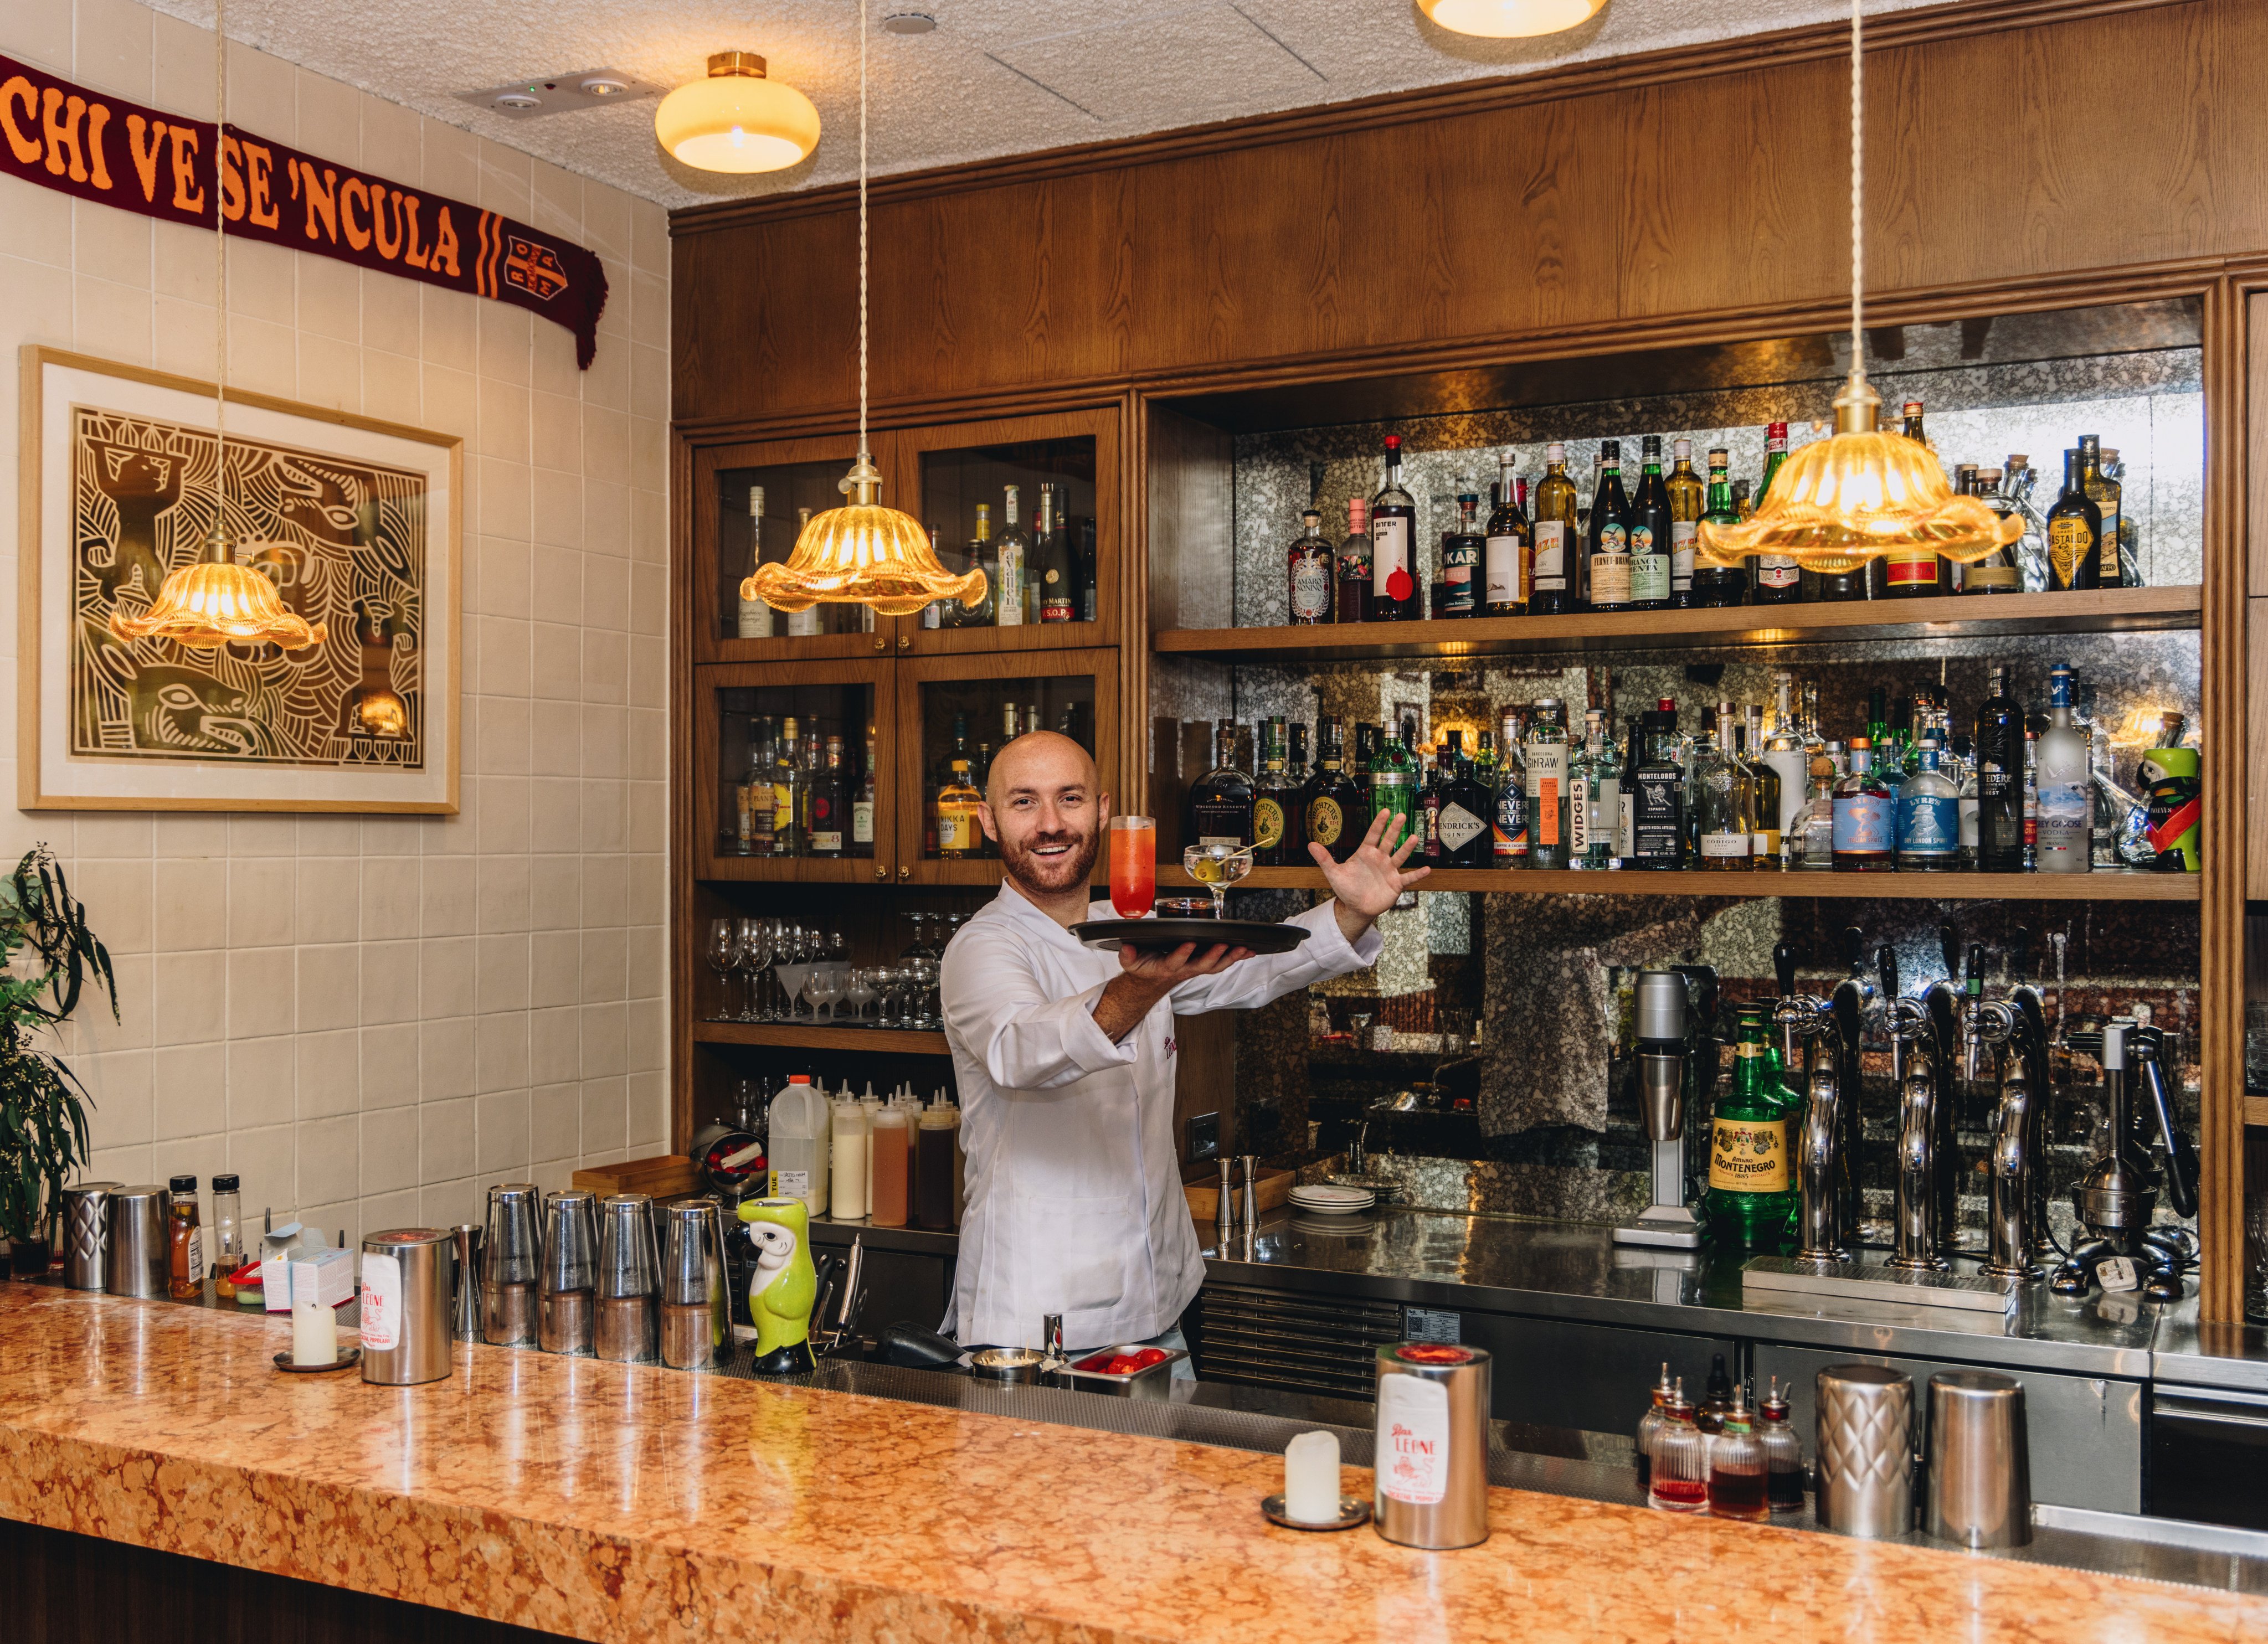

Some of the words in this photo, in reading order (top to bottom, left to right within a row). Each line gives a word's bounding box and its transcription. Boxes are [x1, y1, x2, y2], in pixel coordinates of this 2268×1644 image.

[0, 76, 112, 190] CHI
[126, 114, 204, 214] VE
[215, 135, 279, 230] SE
[288, 158, 461, 277] 'NCULA
[1889, 565, 1933, 576] NTORCIA
[1006, 551, 1015, 605] avallen
[1528, 757, 1559, 769] GINRAW
[1979, 774, 2012, 782] VEDERE
[1850, 797, 1881, 806] LYRE'S
[1910, 797, 1942, 806] LYRE'S
[1254, 803, 1279, 821] MICHTER'S
[1312, 802, 1338, 820] MICHTER'S
[1573, 784, 1584, 848] WIDGES
[831, 834, 840, 843] 8
[1714, 1153, 1776, 1173] MONTENEGRO
[362, 1281, 371, 1292] Bar
[363, 1292, 384, 1307] LEONE
[1391, 1423, 1412, 1436] Bar
[1396, 1437, 1437, 1455] LEONE
